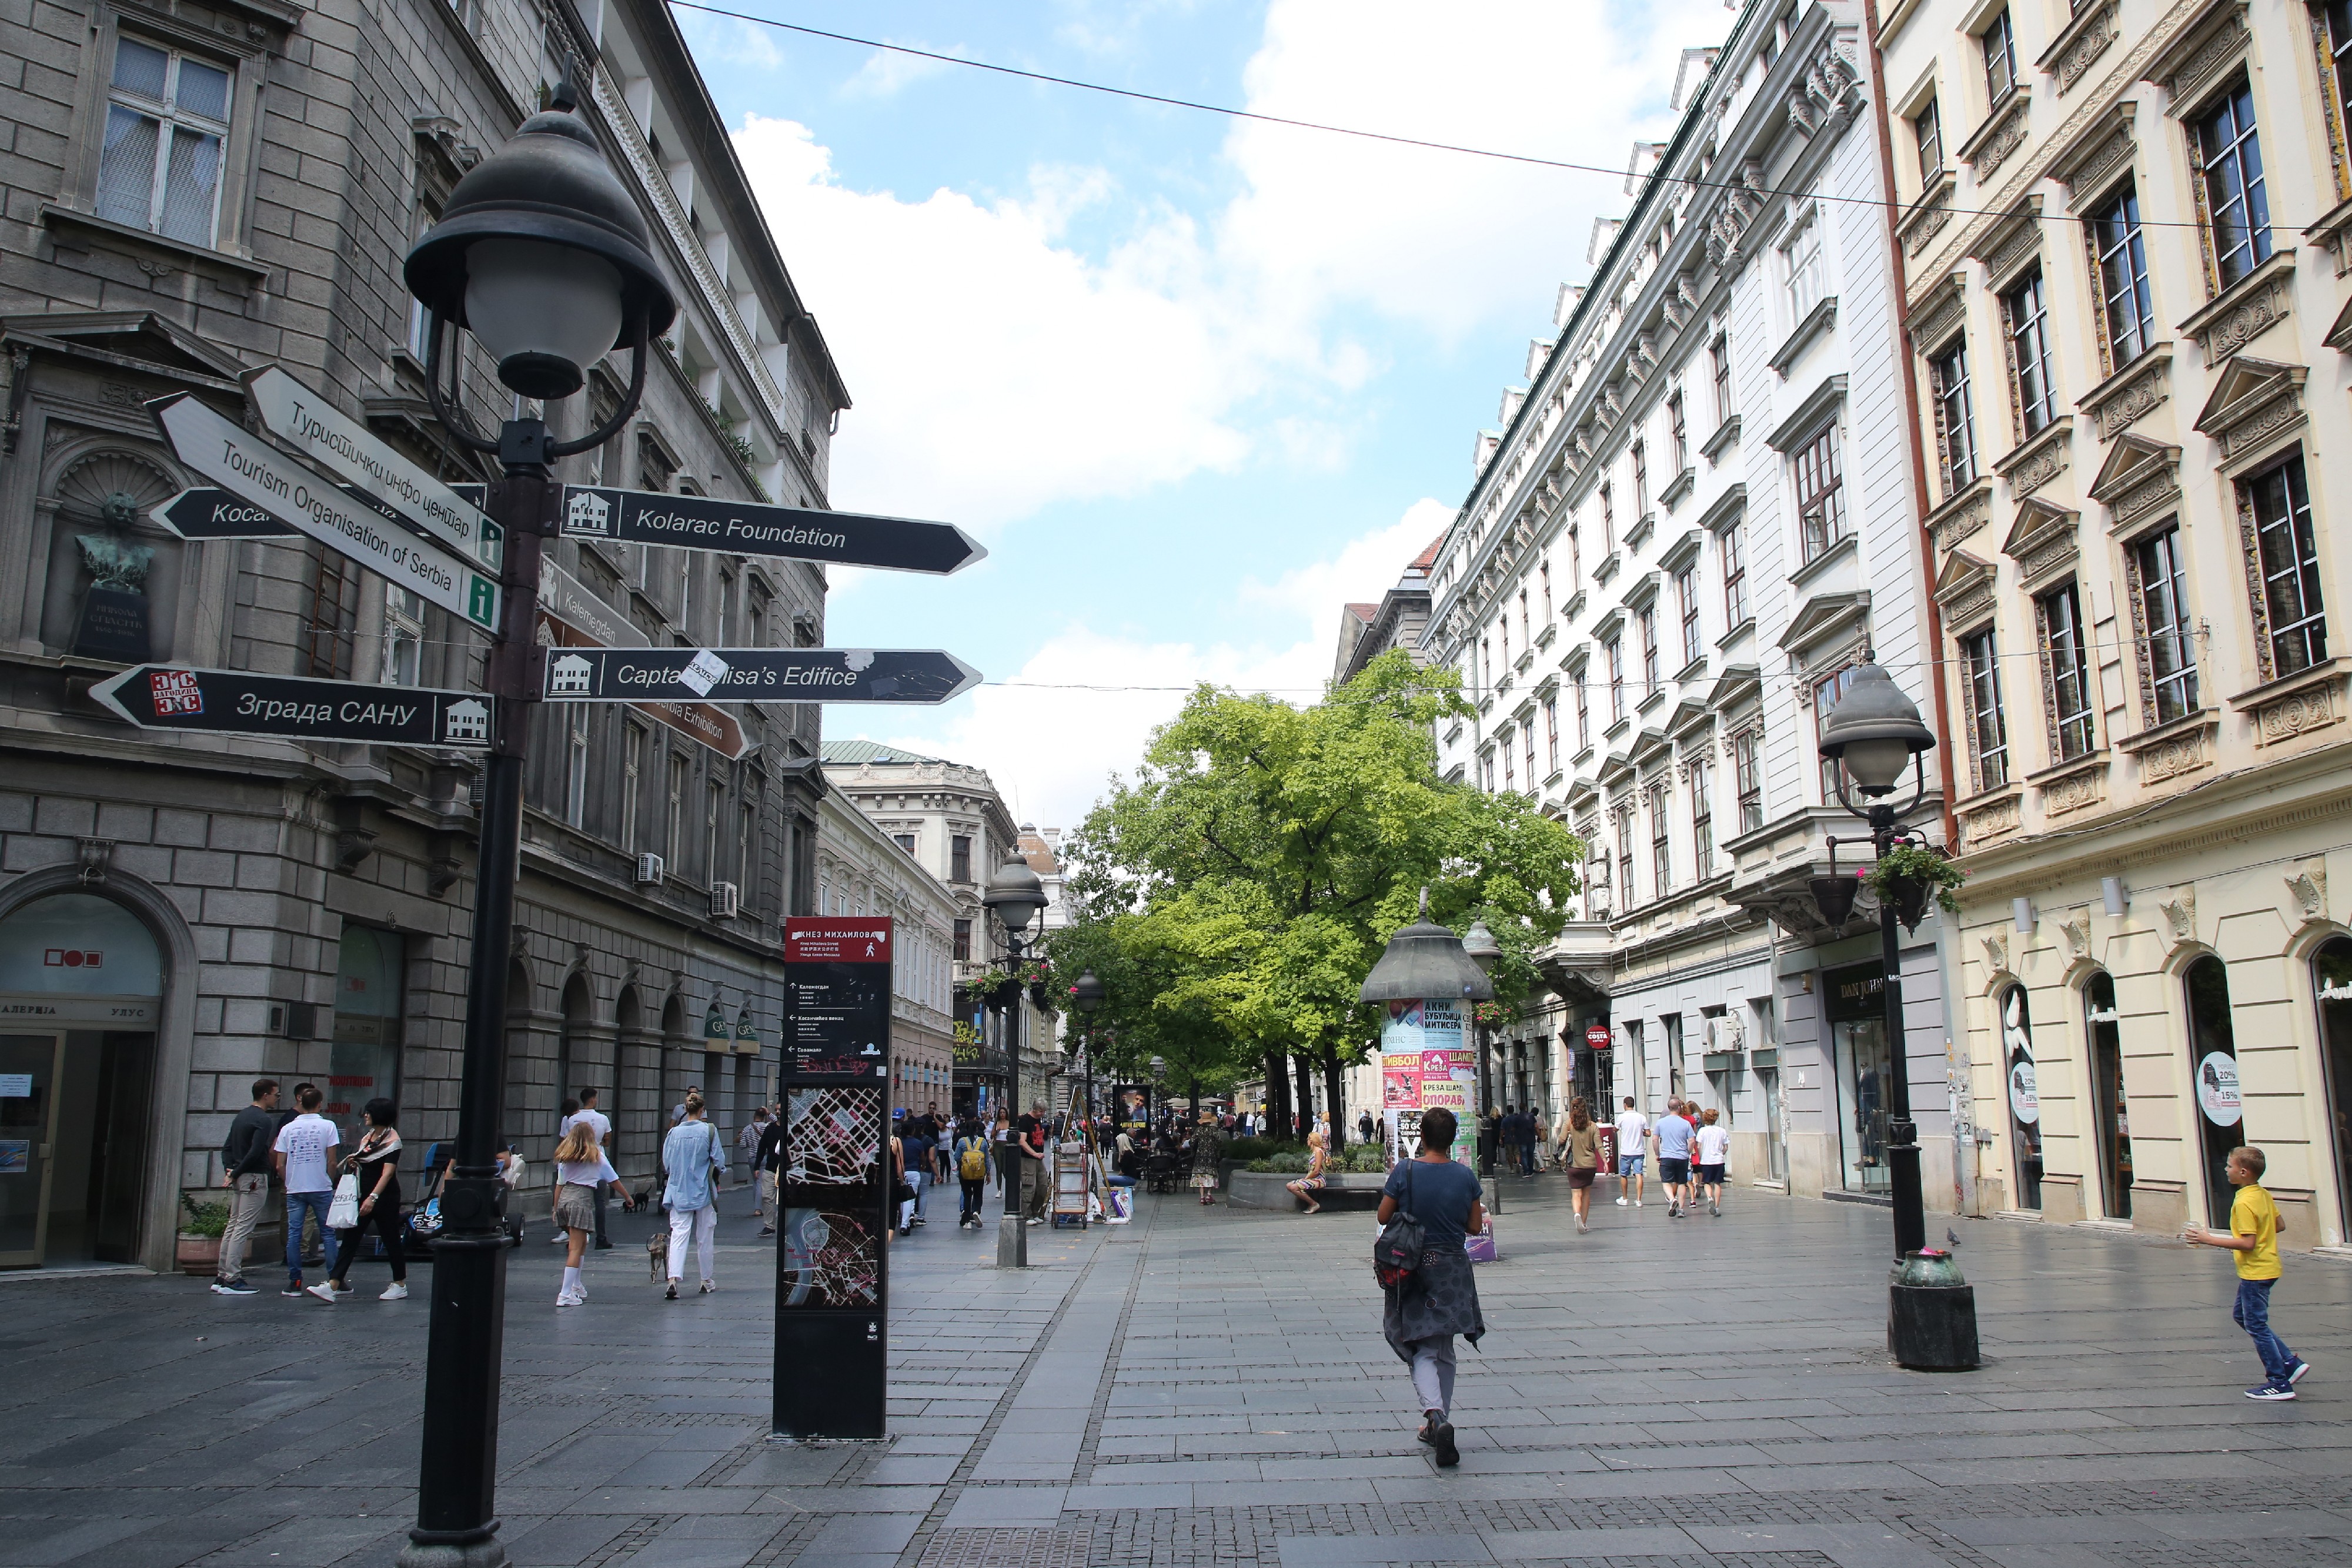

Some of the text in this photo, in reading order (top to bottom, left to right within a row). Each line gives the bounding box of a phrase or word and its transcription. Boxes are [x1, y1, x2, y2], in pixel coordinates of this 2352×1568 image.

[293, 401, 469, 537] Туристички инфо центар
[212, 504, 269, 522] Коса
[224, 440, 452, 591] Tourism Organisation of Serbia
[636, 510, 846, 548] Kolarac Foundation
[565, 592, 616, 643] Kalemegdan
[617, 664, 681, 690] Capta
[783, 666, 857, 686] Edifice
[154, 688, 198, 698] ЈАГОДИНА
[236, 693, 417, 726] Зграда САНУ
[684, 706, 723, 740] Exhibition
[1841, 978, 1883, 999] DAN JOHN
[0, 1005, 56, 1015] АЛЕРИЈА
[111, 1008, 143, 1017] УЛУС
[1425, 1002, 1450, 1011] АКНИ
[1425, 1012, 1461, 1021] БУБУЉИЦА
[1425, 1021, 1461, 1029] МИТИСЕРА
[2219, 1070, 2236, 1079] 20%
[2221, 1091, 2238, 1100] 15%
